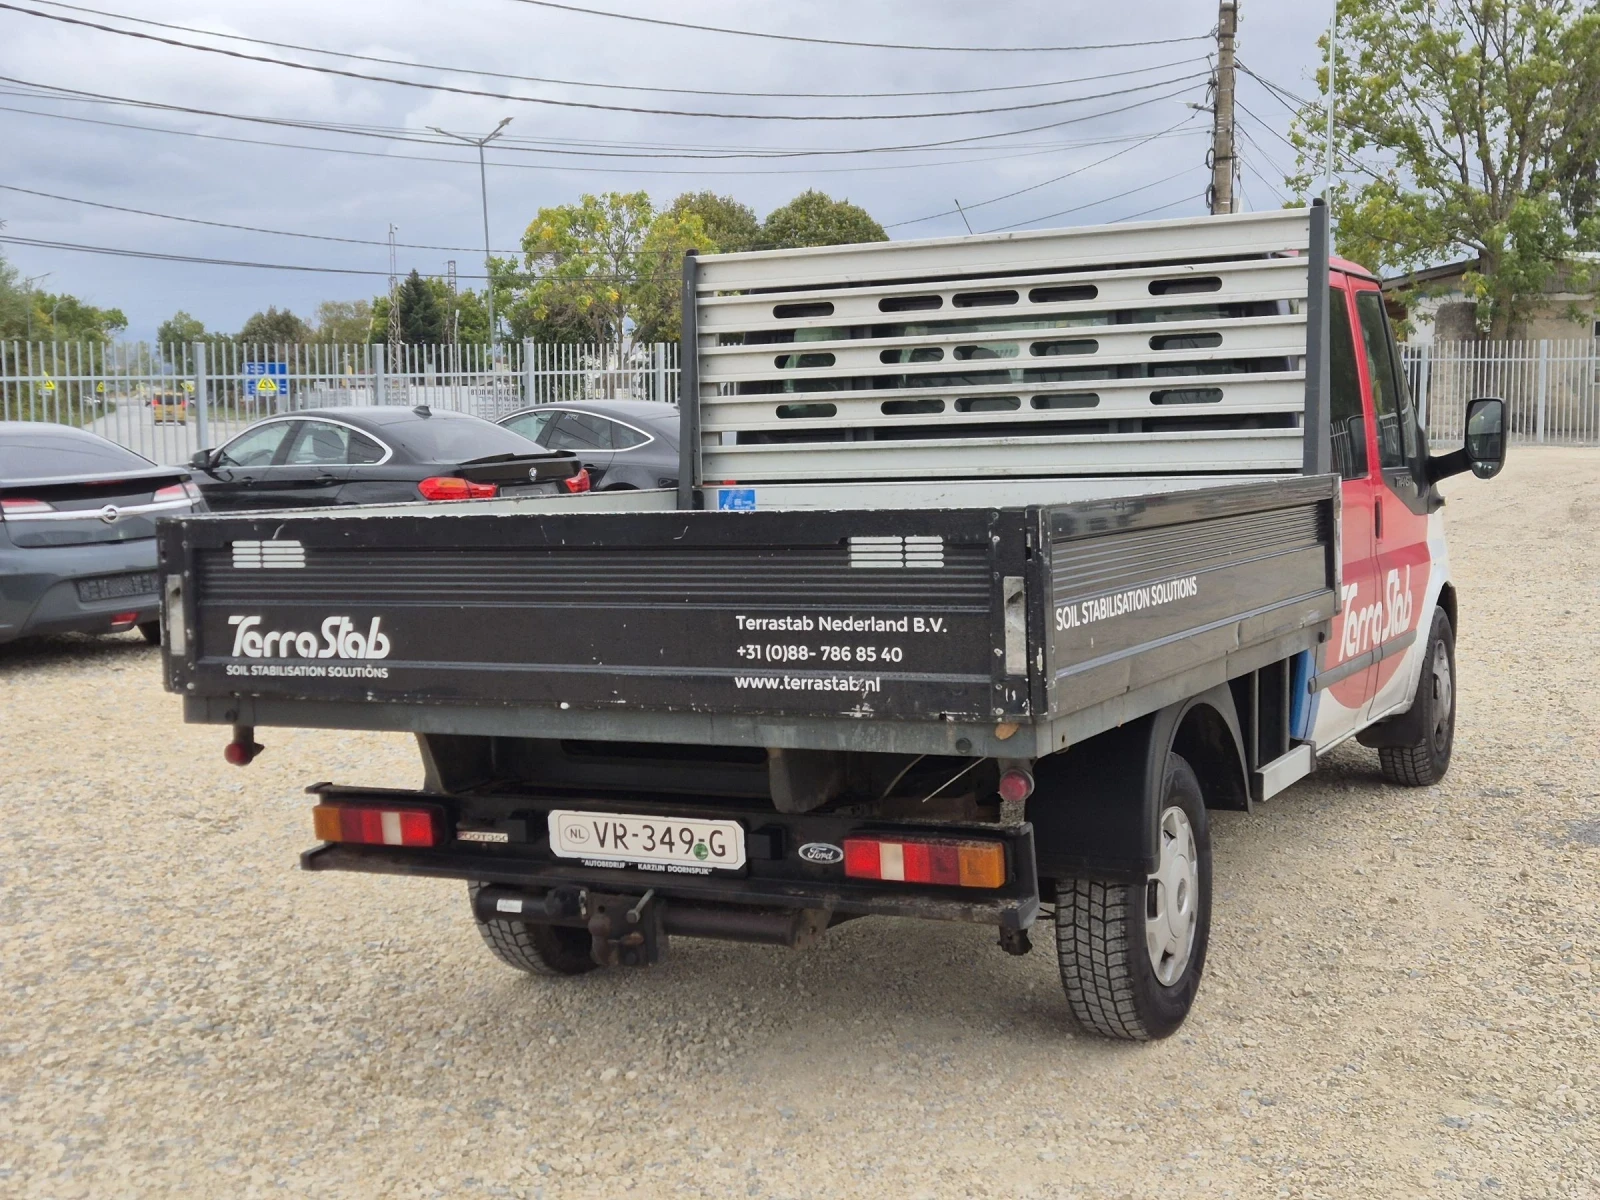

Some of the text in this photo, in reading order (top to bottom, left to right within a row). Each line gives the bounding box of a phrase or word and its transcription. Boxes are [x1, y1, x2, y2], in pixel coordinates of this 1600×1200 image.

[1056, 576, 1198, 631] SOIL STABILISATION SOLUTIONS
[735, 615, 948, 633] Terrastab Nederland B.V.
[736, 644, 903, 662] +31 (0)88- 786 85 40
[226, 665, 389, 678] SOIL STABILISATION SOLUTIONS
[734, 675, 881, 692] www.terrastab.nl
[570, 829, 585, 839] NL
[593, 821, 726, 857] VR-349-G
[807, 846, 834, 861] Ford
